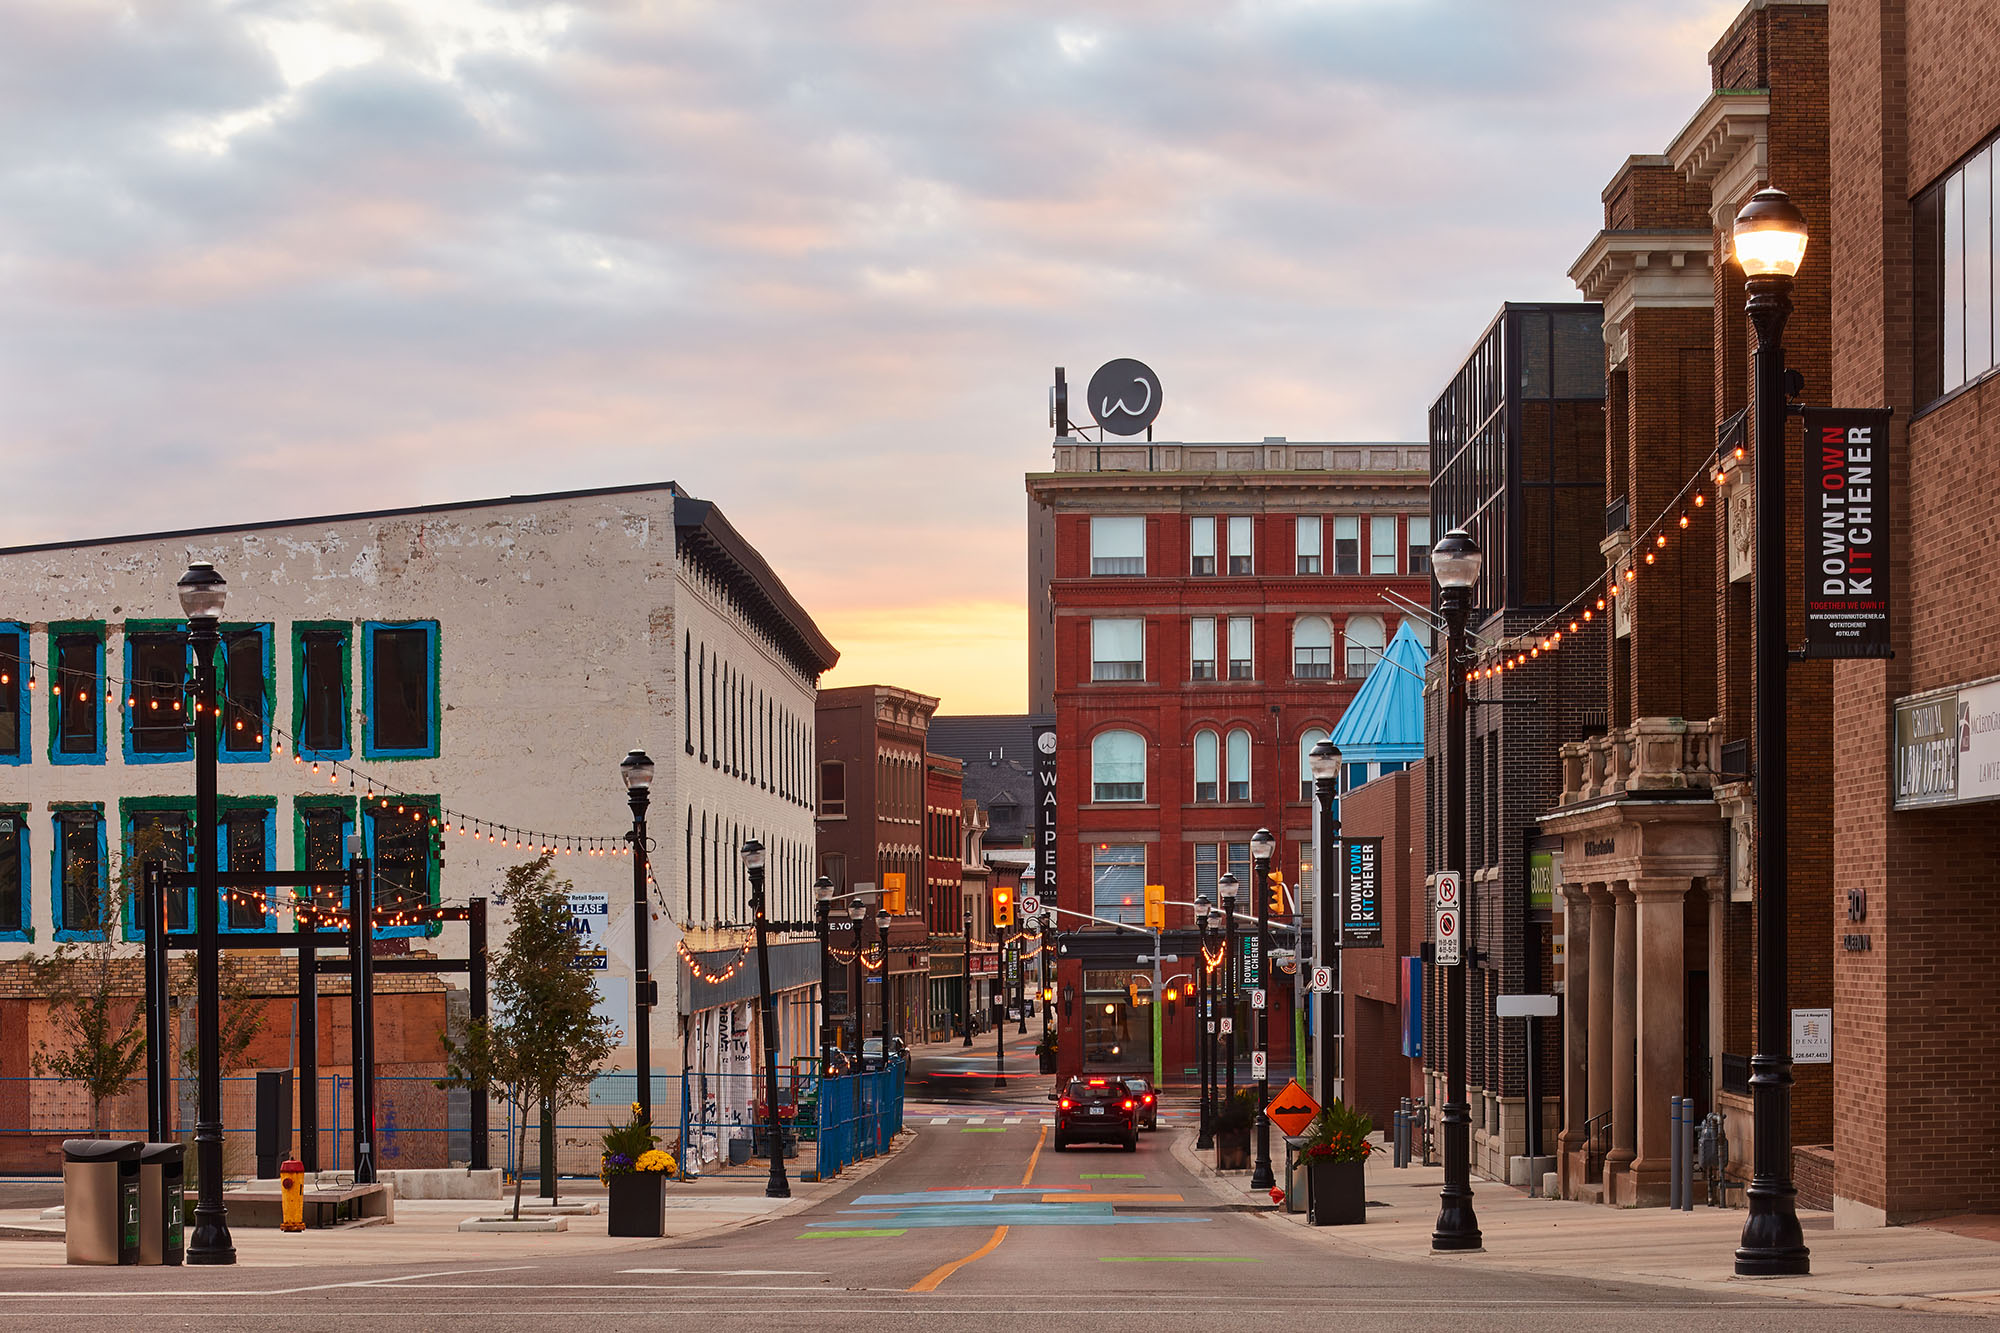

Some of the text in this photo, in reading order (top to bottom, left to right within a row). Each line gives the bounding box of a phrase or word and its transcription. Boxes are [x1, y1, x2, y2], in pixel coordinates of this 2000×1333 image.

[1822, 427, 1846, 596] DOWNTOWN
[1848, 426, 1872, 596] KITCHENER
[1810, 601, 1885, 610] TOGETHER WE OWN IT
[1900, 738, 1955, 797] LAW OFFICE
[1040, 771, 1057, 885] WALPER
[588, 894, 605, 903] Space
[1350, 844, 1362, 921] DOWNTOWN
[1362, 844, 1374, 921] KITCHENER
[1848, 888, 1865, 921] 30
[570, 905, 603, 914] LEASE
[1243, 936, 1251, 984] DOWNTOWN
[1251, 936, 1259, 983] KITCHENER
